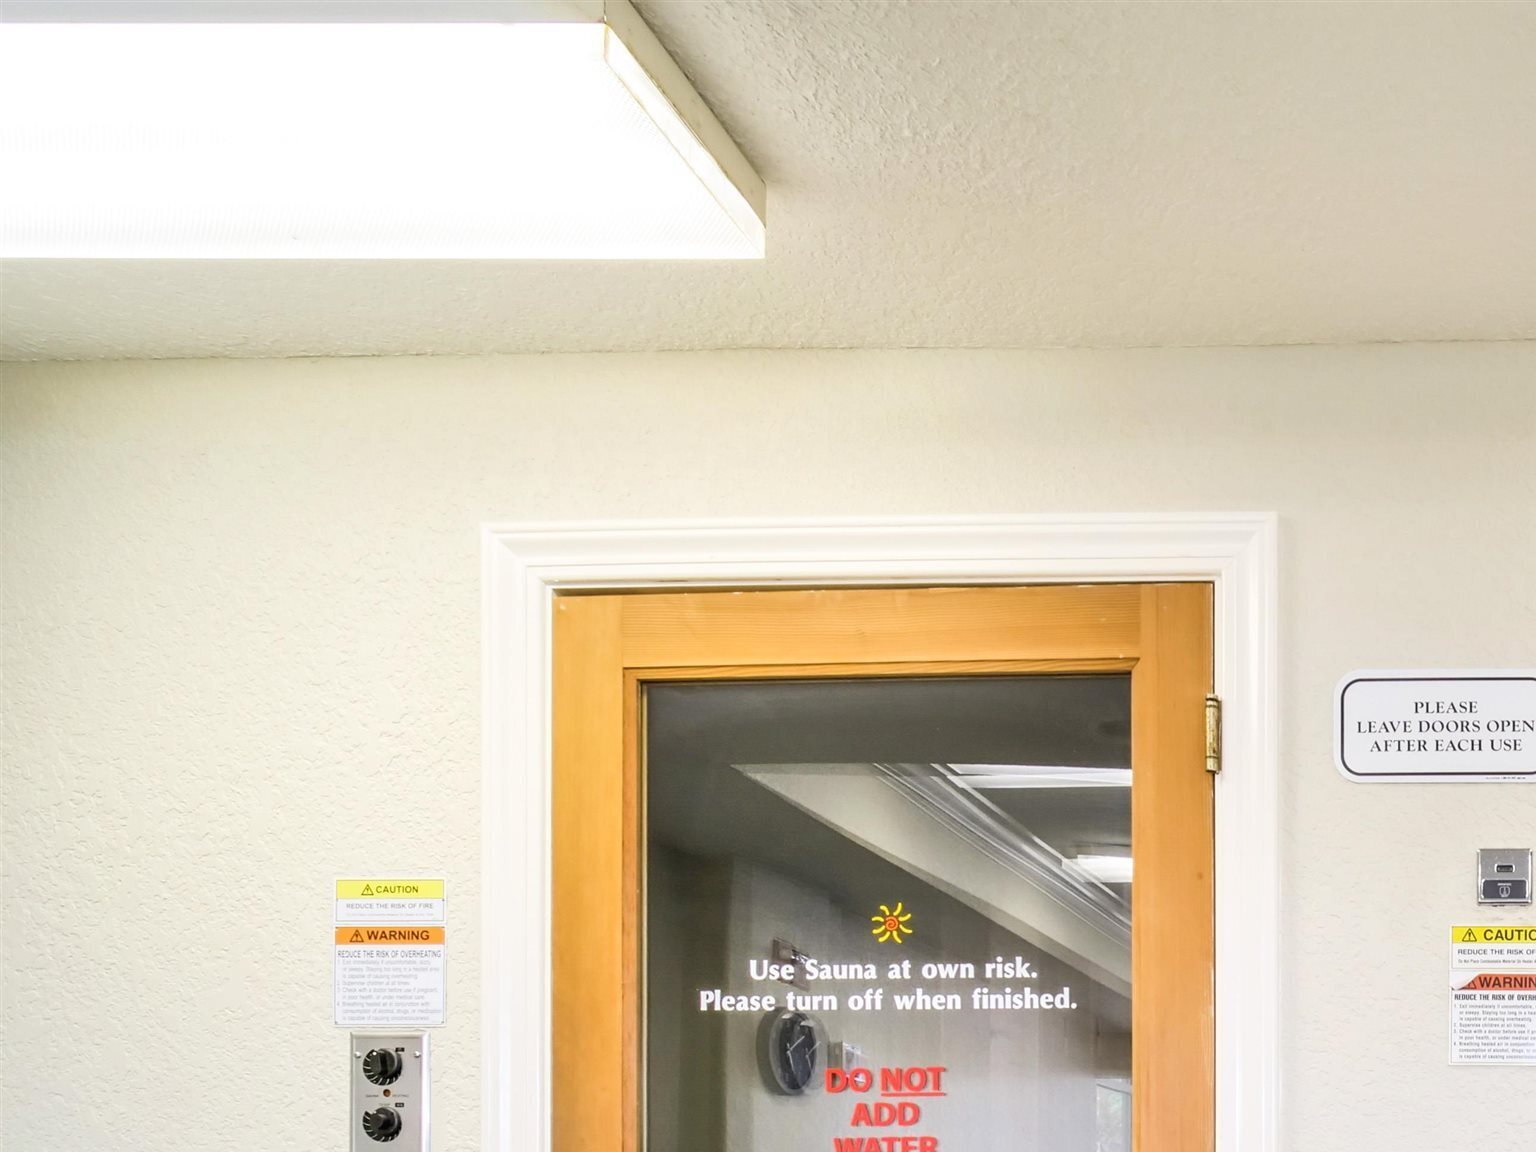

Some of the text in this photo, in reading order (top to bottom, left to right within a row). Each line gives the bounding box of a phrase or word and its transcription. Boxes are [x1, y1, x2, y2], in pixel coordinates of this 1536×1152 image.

[1414, 702, 1478, 713] PLEASE
[1358, 720, 1535, 733] LEAVE DOORS OPEN
[1371, 739, 1523, 752] AFTER EACH USE
[375, 885, 419, 894] CAUTION
[366, 930, 430, 941] WARNING
[337, 950, 441, 958] REDUCE THE RISK OF OVERHEATING
[750, 957, 1037, 980] Use Sauna at own risk.
[700, 988, 1077, 1011] Please turn off when finished.
[825, 1067, 946, 1096] DO NOT
[851, 1102, 920, 1127] ADD
